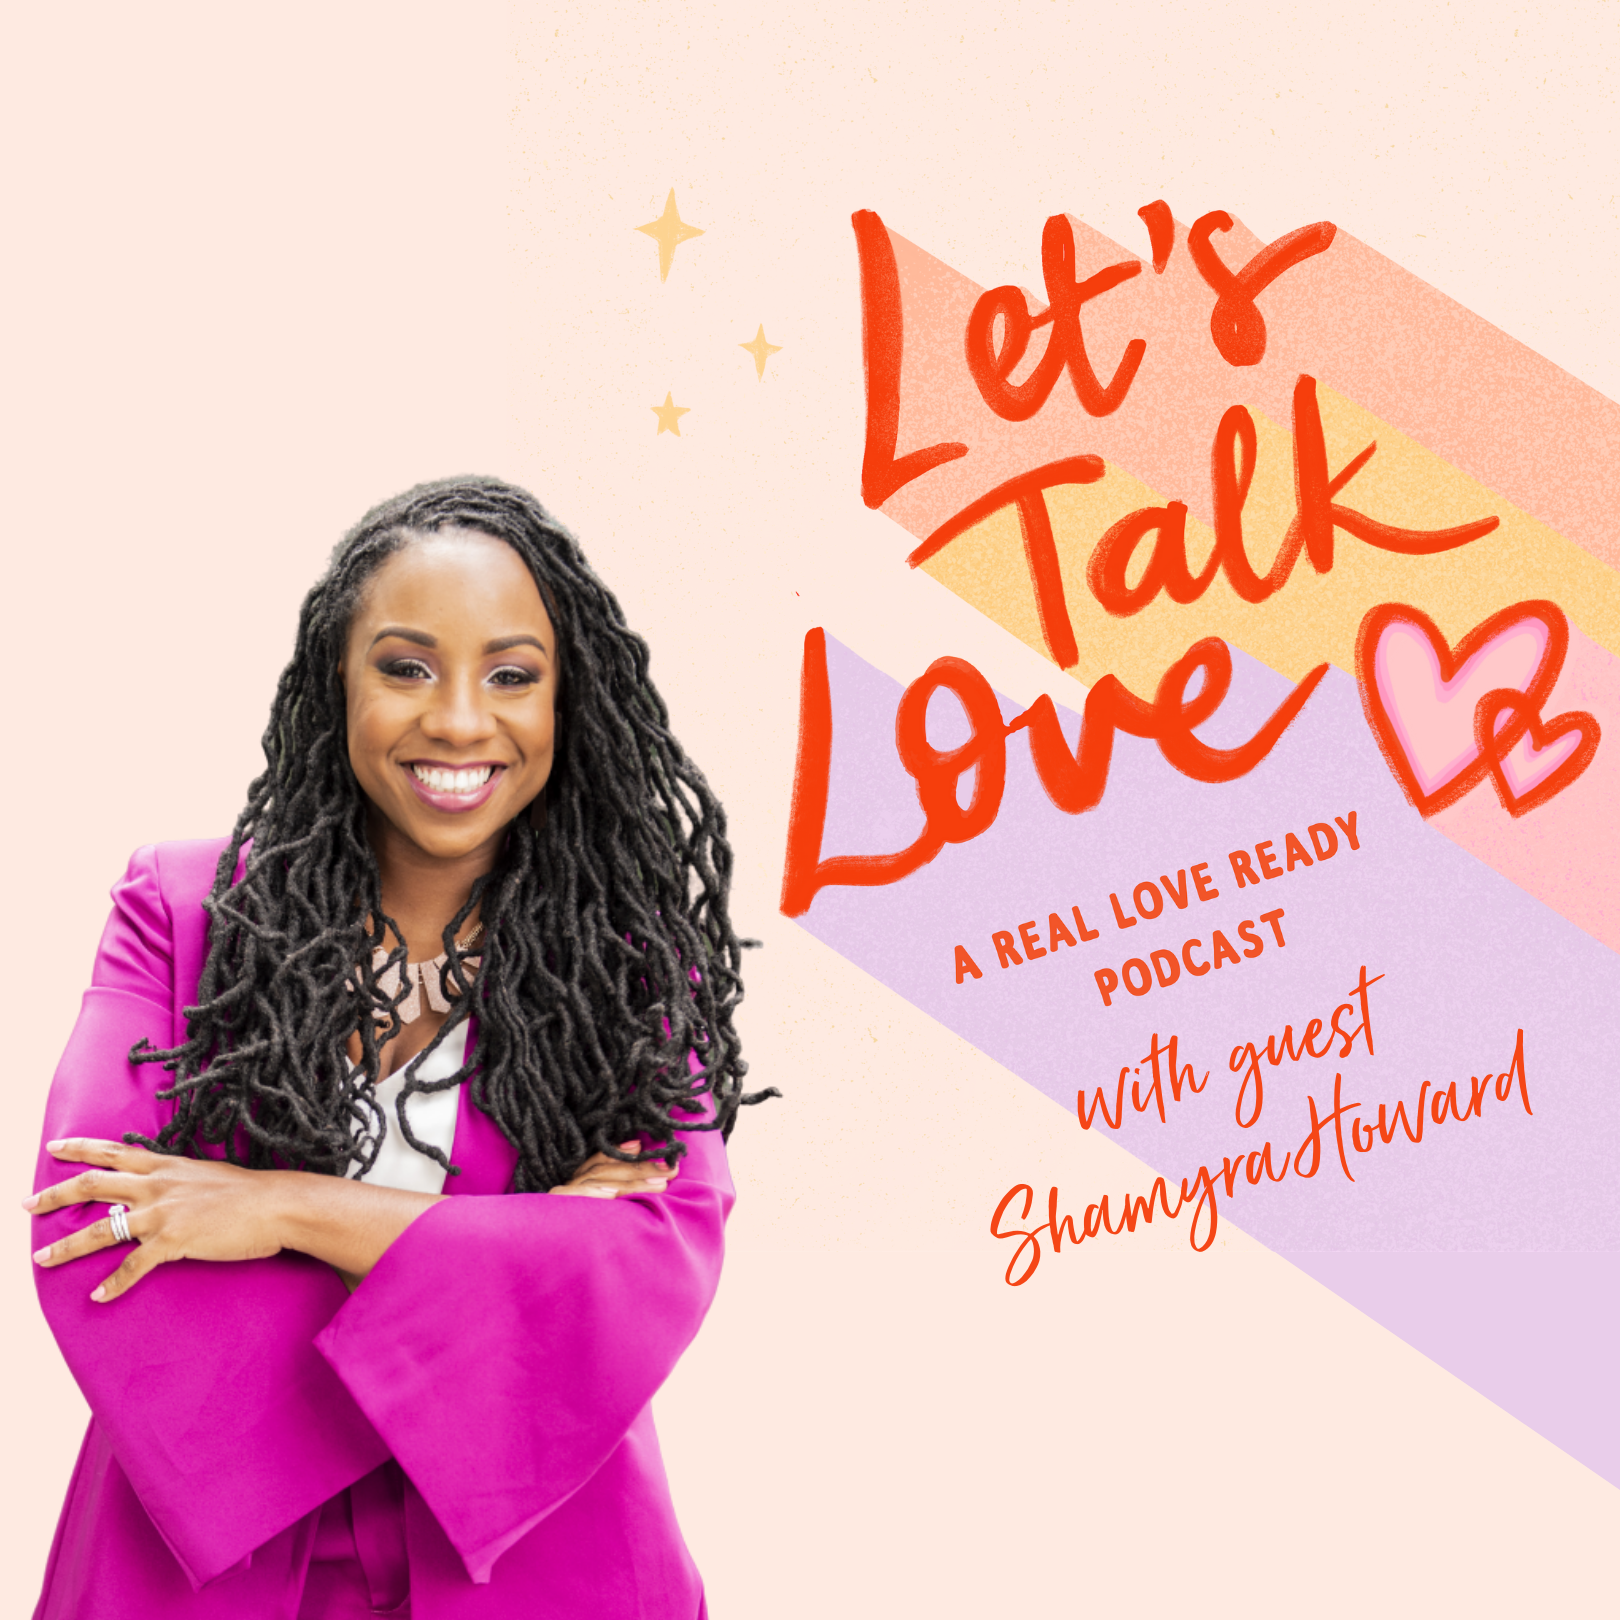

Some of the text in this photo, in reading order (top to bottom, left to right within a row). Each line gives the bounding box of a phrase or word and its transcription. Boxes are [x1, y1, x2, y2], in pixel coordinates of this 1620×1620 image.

[851, 199, 1338, 510] Let's
[906, 373, 1501, 673] Talk
[779, 626, 1331, 919] Love
[954, 810, 1362, 985] A REAL LOVE READY
[1077, 965, 1386, 1131] with guest
[1093, 908, 1288, 1007] PODCAST
[990, 1028, 1534, 1287] Shamyra Howard
